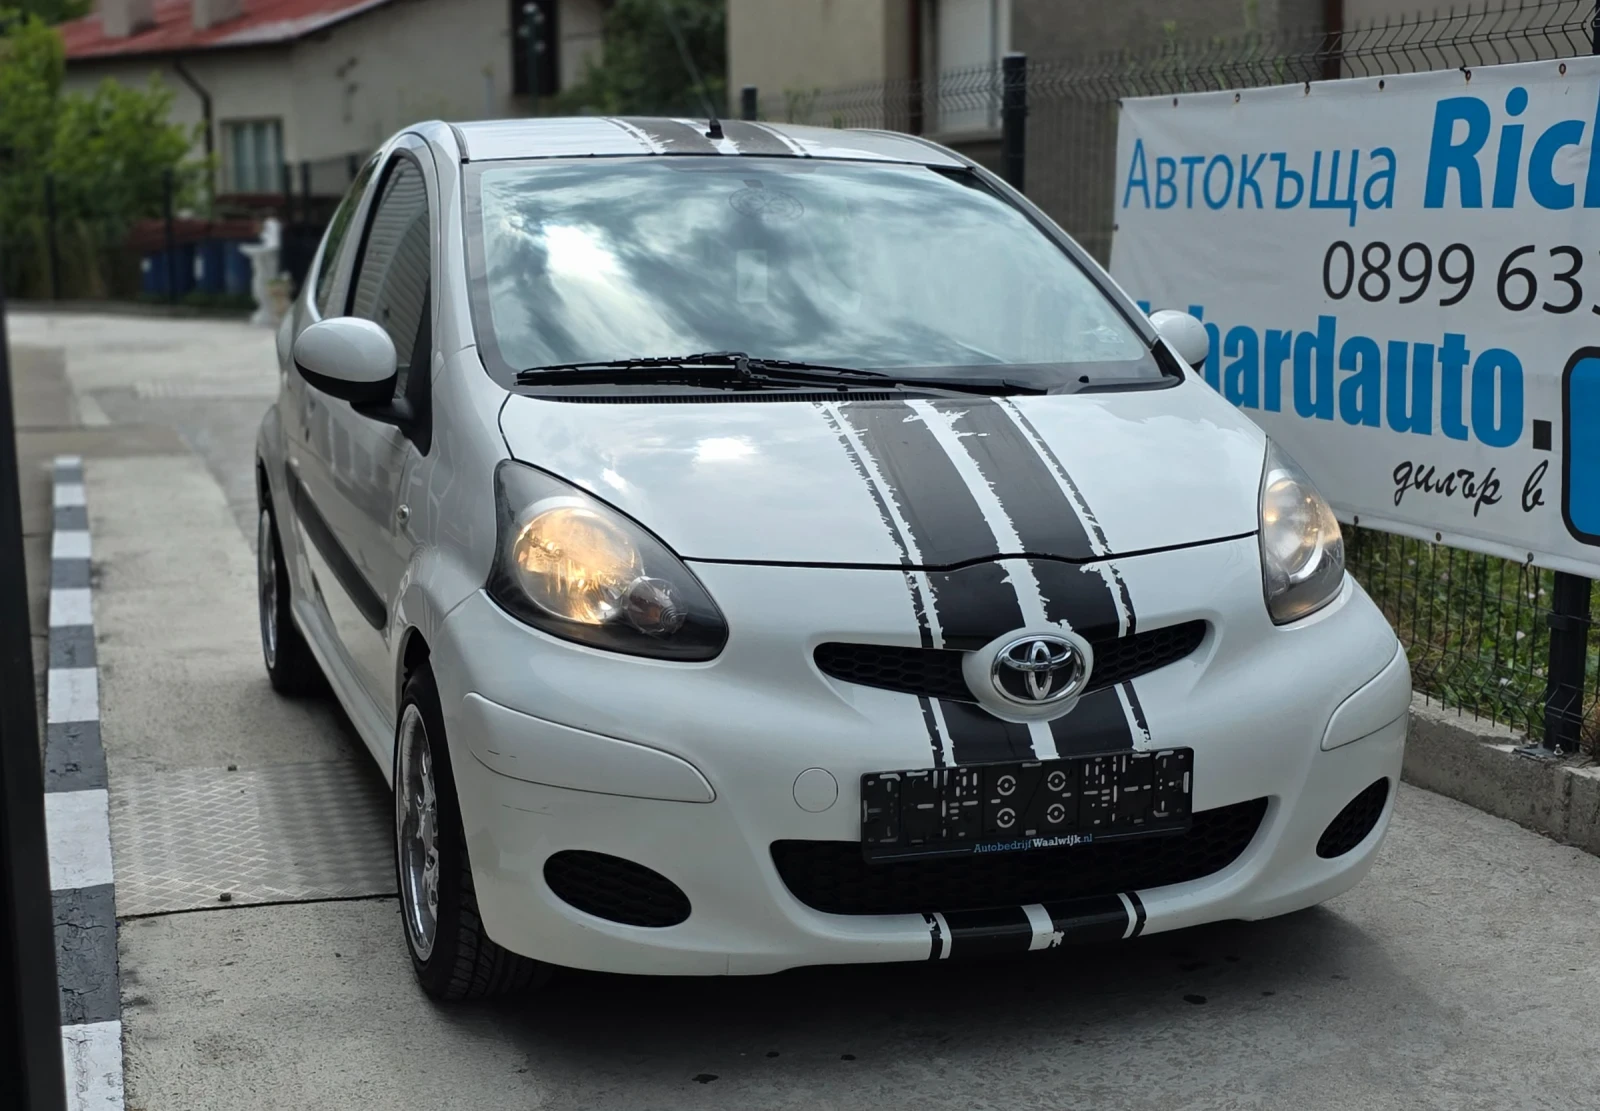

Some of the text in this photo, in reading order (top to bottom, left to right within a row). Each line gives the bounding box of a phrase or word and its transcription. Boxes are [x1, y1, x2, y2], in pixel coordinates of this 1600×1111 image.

[1122, 137, 1398, 228] Автокъща
[1322, 240, 1600, 317] 0899 63
